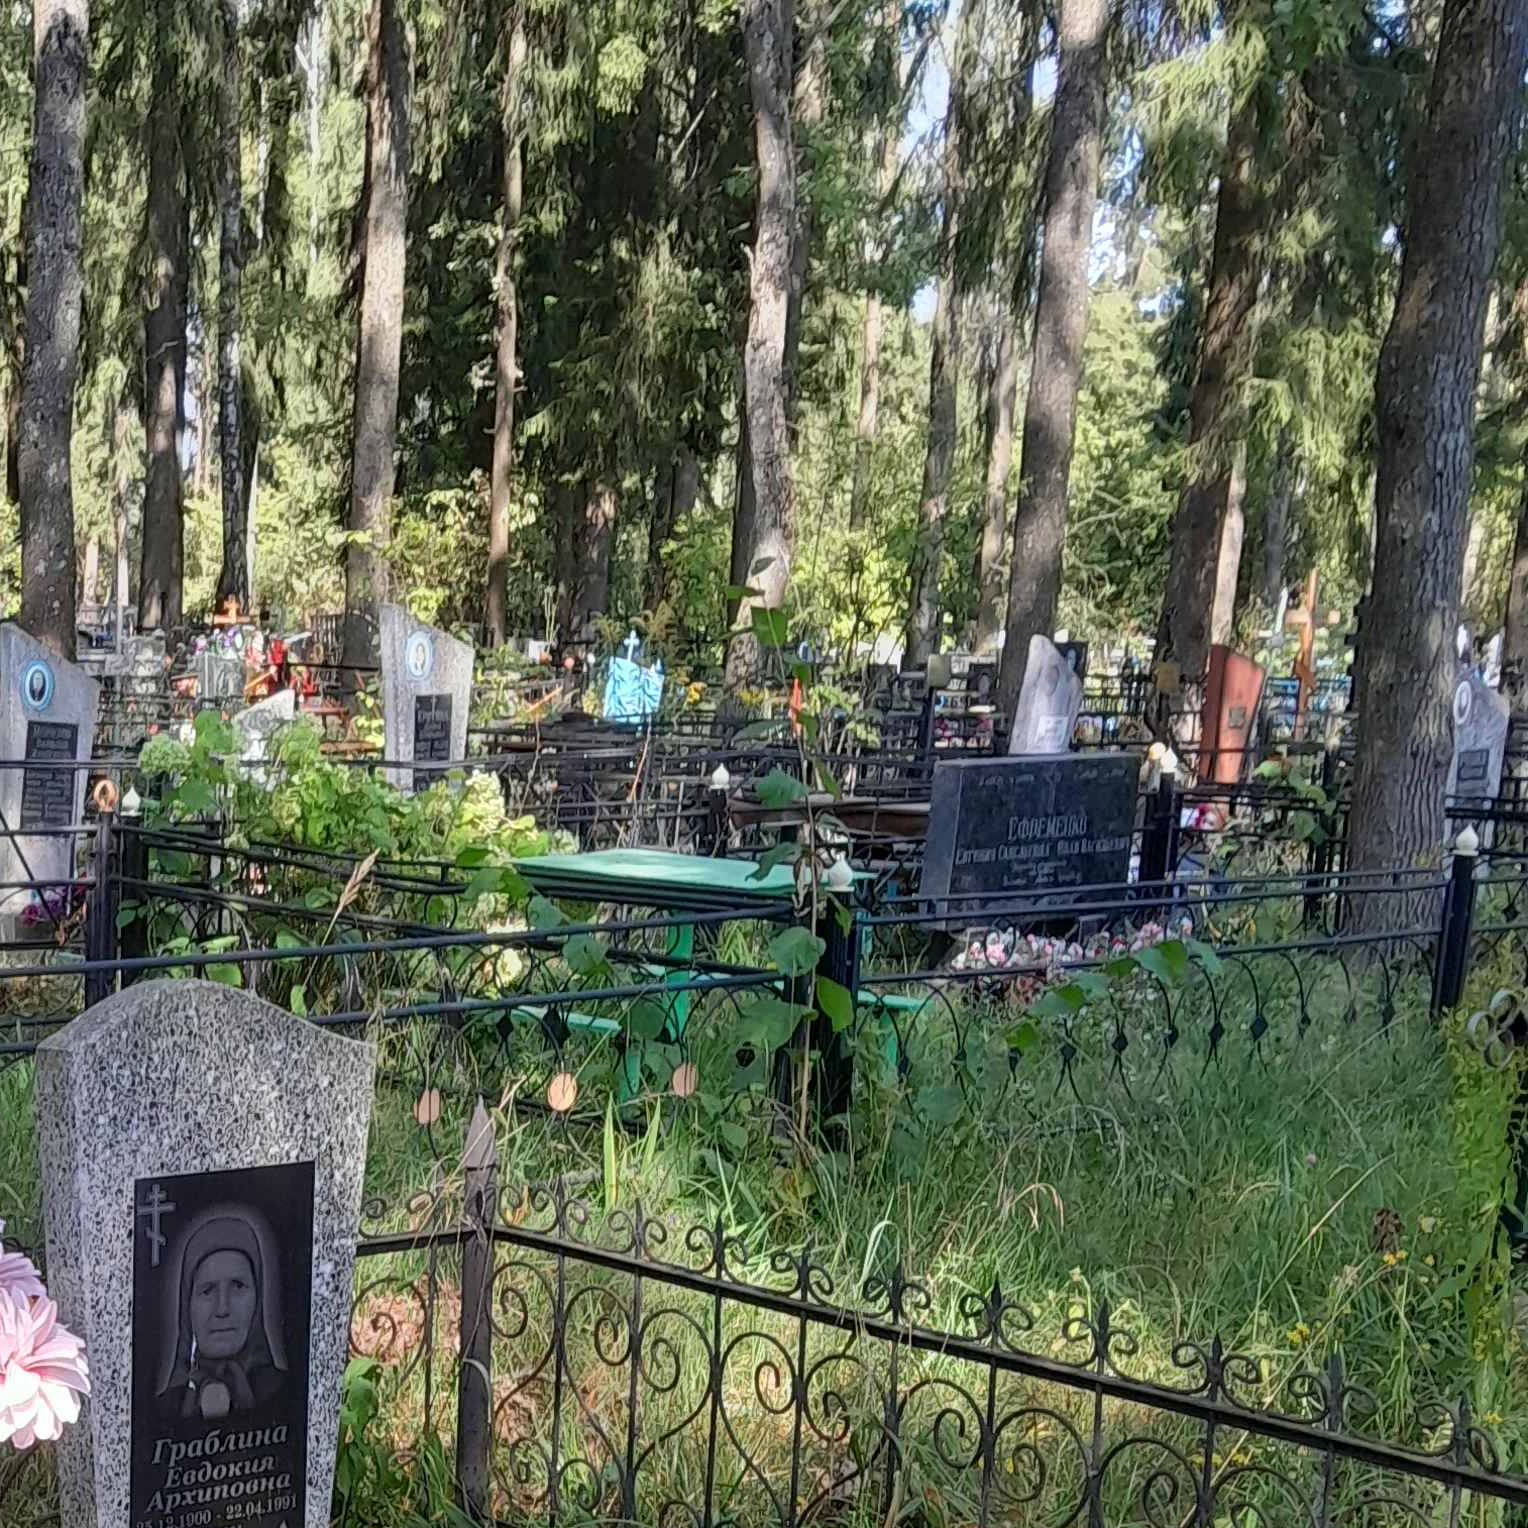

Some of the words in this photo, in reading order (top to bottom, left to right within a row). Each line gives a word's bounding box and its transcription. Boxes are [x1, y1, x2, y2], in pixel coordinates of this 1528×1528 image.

[151, 1425, 287, 1469] Граблина
[144, 1472, 292, 1514] Архиповна
[164, 1455, 275, 1489] Евдокия
